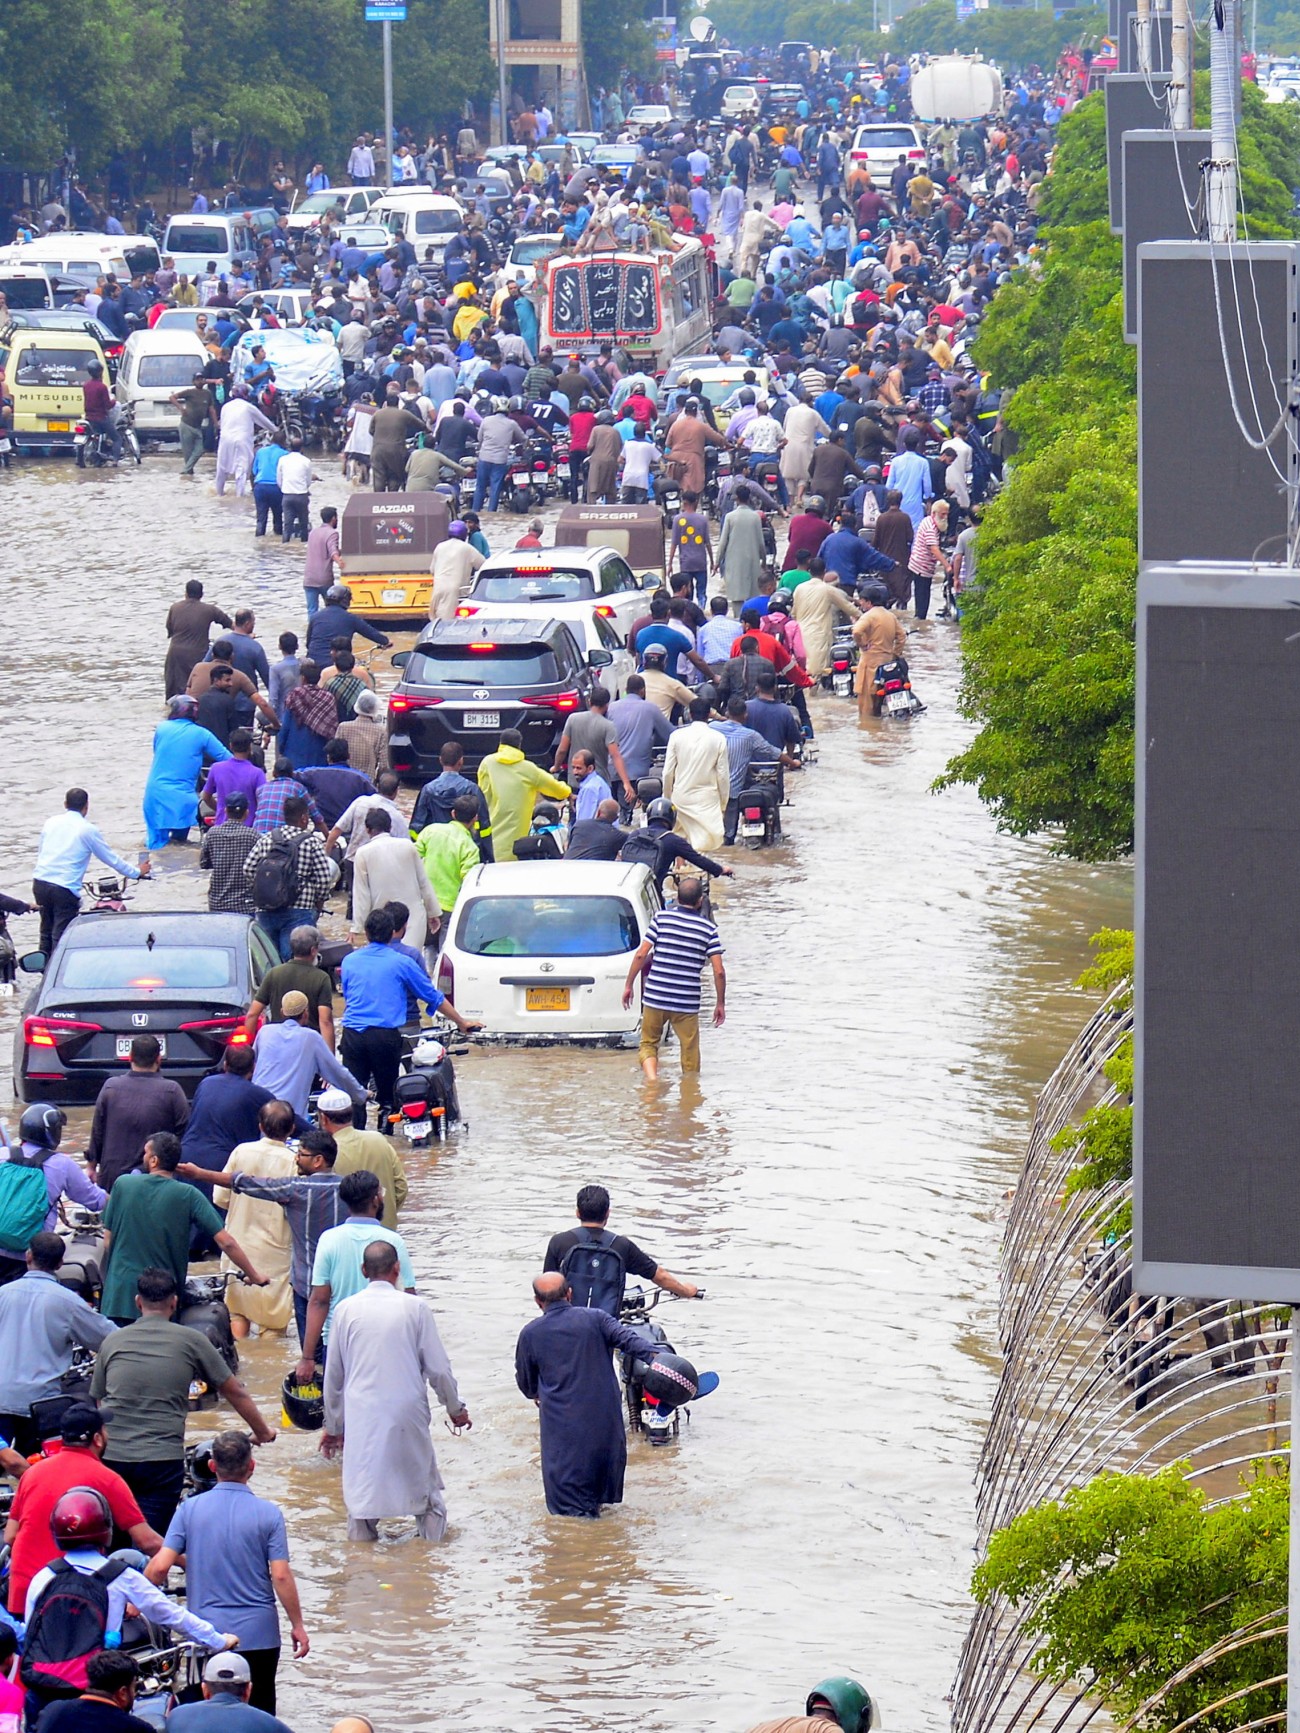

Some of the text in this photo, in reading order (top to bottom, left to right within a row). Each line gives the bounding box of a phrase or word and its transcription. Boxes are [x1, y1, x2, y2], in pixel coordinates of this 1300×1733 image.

[532, 404, 552, 418] 77
[372, 505, 415, 513] SAZGAR
[579, 512, 638, 520] SAZGAR
[480, 714, 499, 725] 3115
